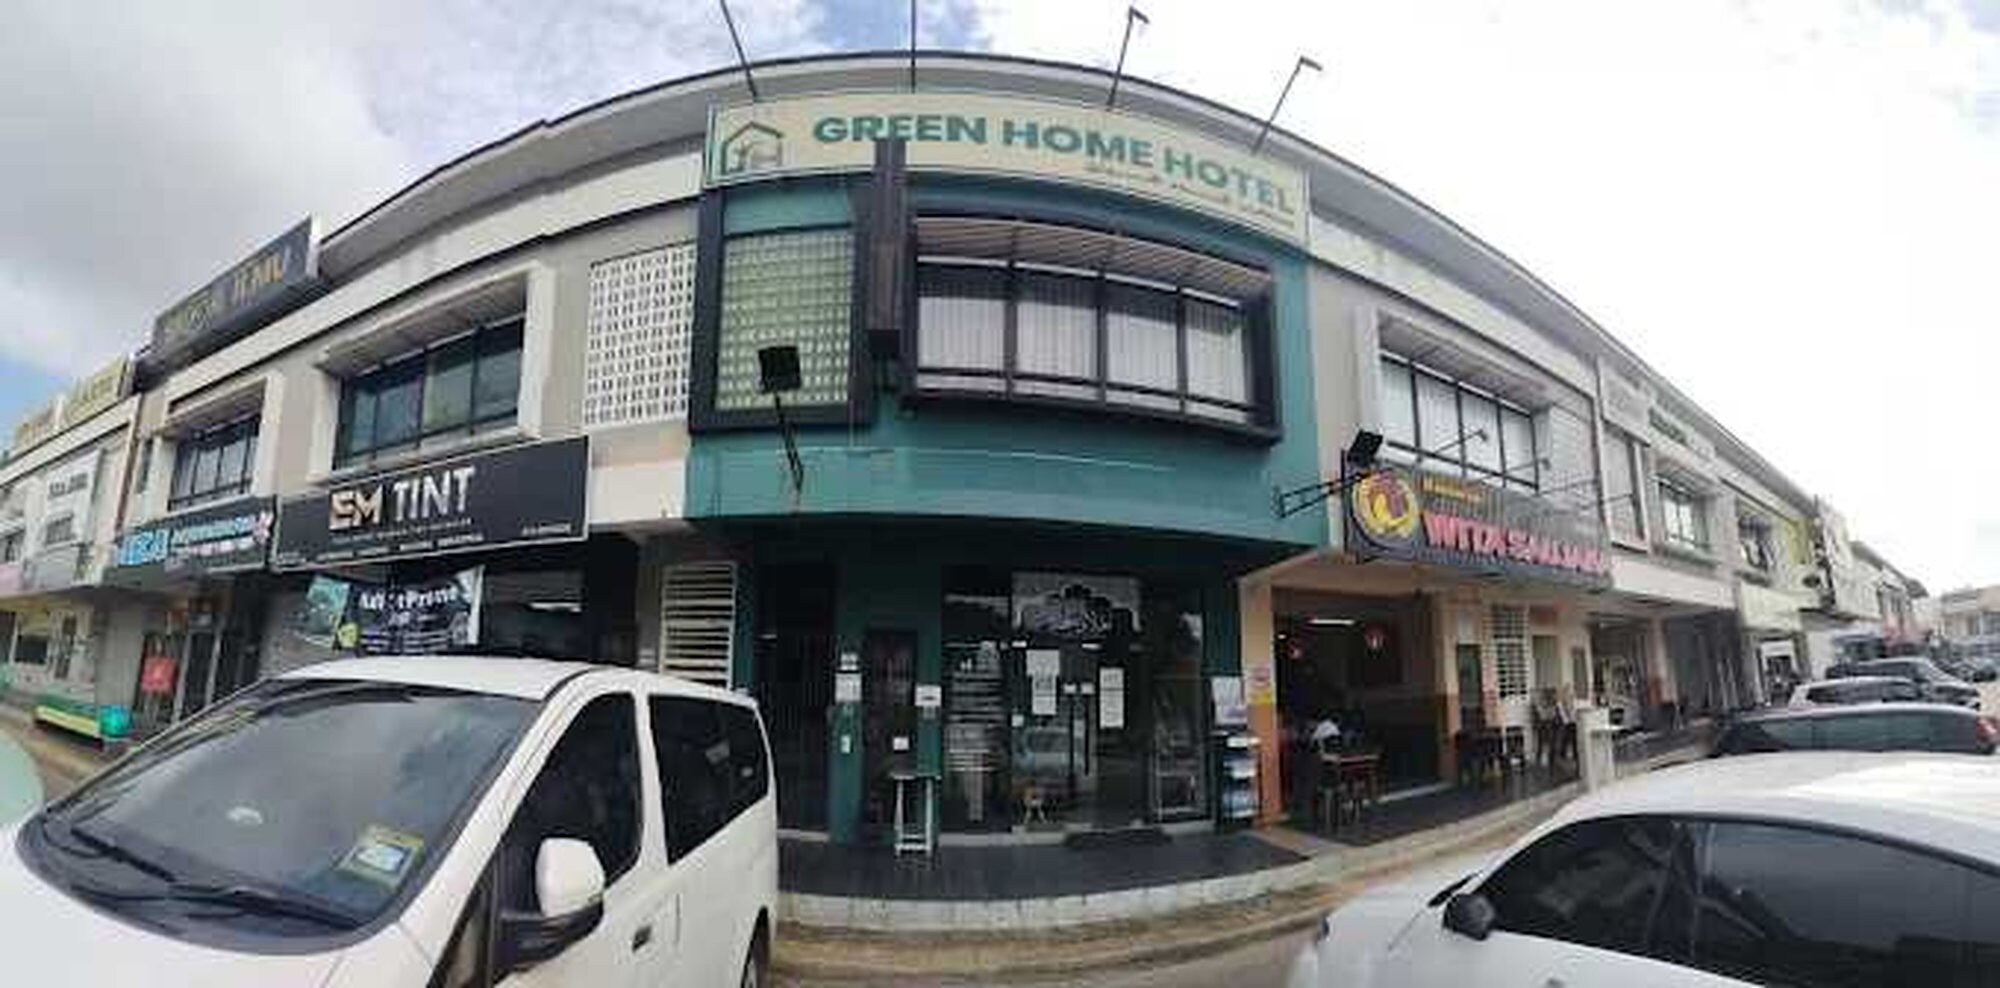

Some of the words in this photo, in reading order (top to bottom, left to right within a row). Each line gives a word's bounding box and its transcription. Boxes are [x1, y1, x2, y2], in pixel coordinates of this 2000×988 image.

[813, 114, 988, 144] GREEN
[1002, 118, 1153, 168] HOME
[1163, 147, 1296, 215] HOTEL
[392, 465, 476, 523] TINT
